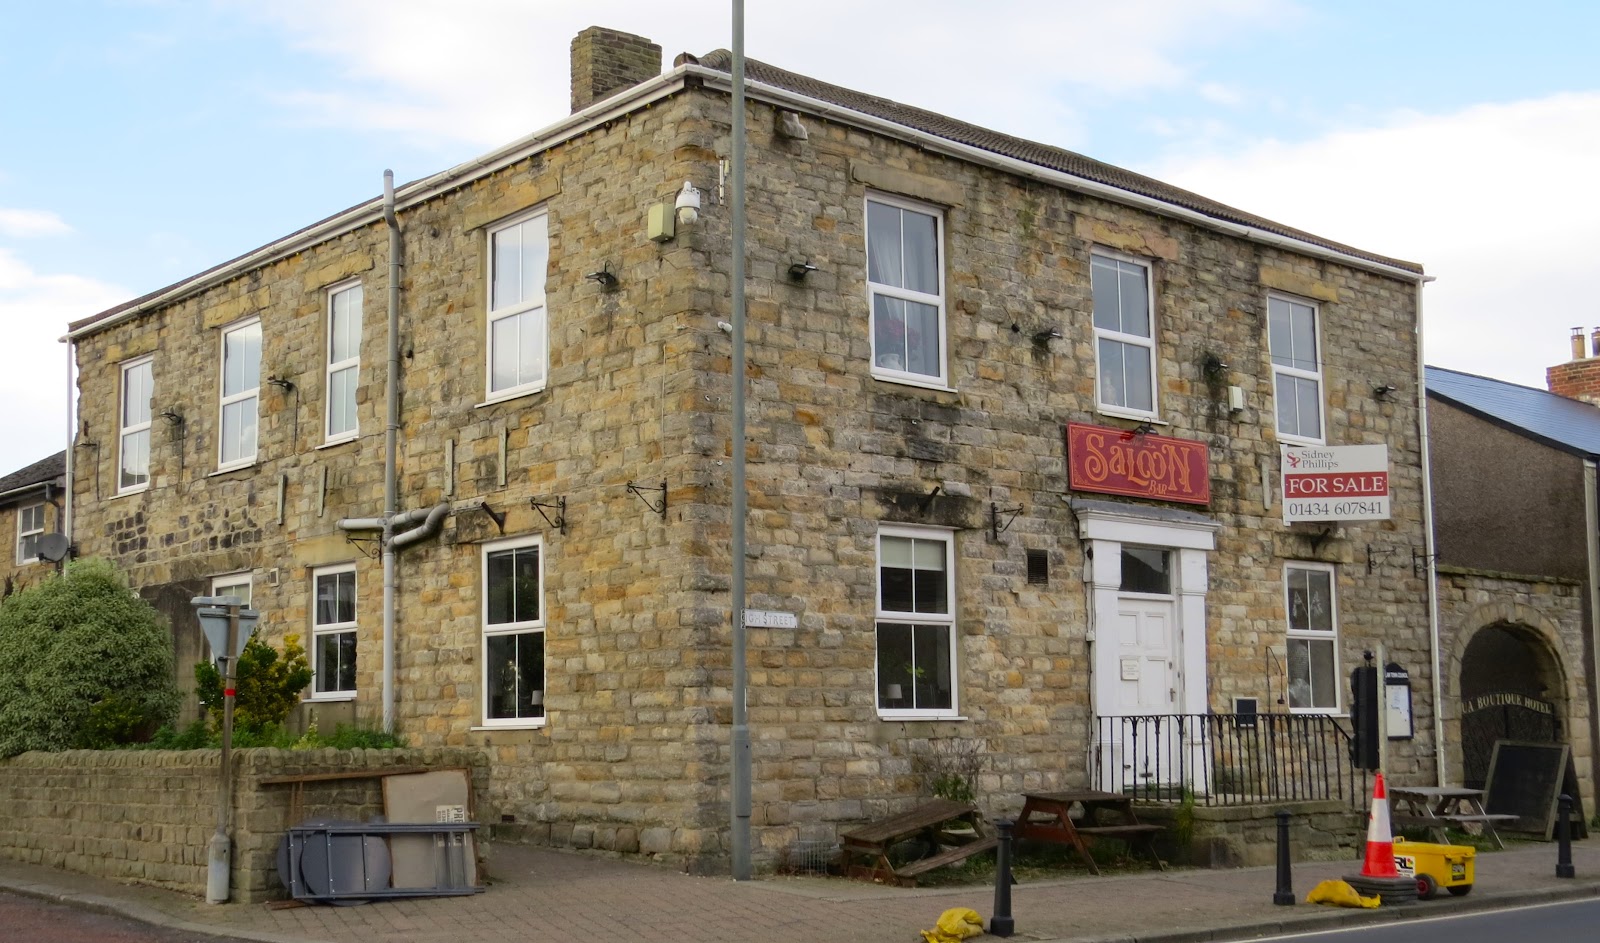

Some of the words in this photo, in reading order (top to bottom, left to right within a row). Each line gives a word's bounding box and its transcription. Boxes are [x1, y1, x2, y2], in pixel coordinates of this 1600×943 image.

[1301, 450, 1334, 459] Sidney
[1302, 460, 1339, 470] Phillips
[1289, 478, 1329, 494] FOR
[1332, 476, 1384, 493] SALE
[1289, 503, 1329, 516] 01434
[1334, 502, 1383, 515] 607841
[745, 613, 761, 624] IGH
[763, 614, 793, 626] STREET
[1461, 701, 1474, 714] UA
[1477, 693, 1522, 710] BOUTIQUE
[1524, 697, 1552, 714] HOTEL
